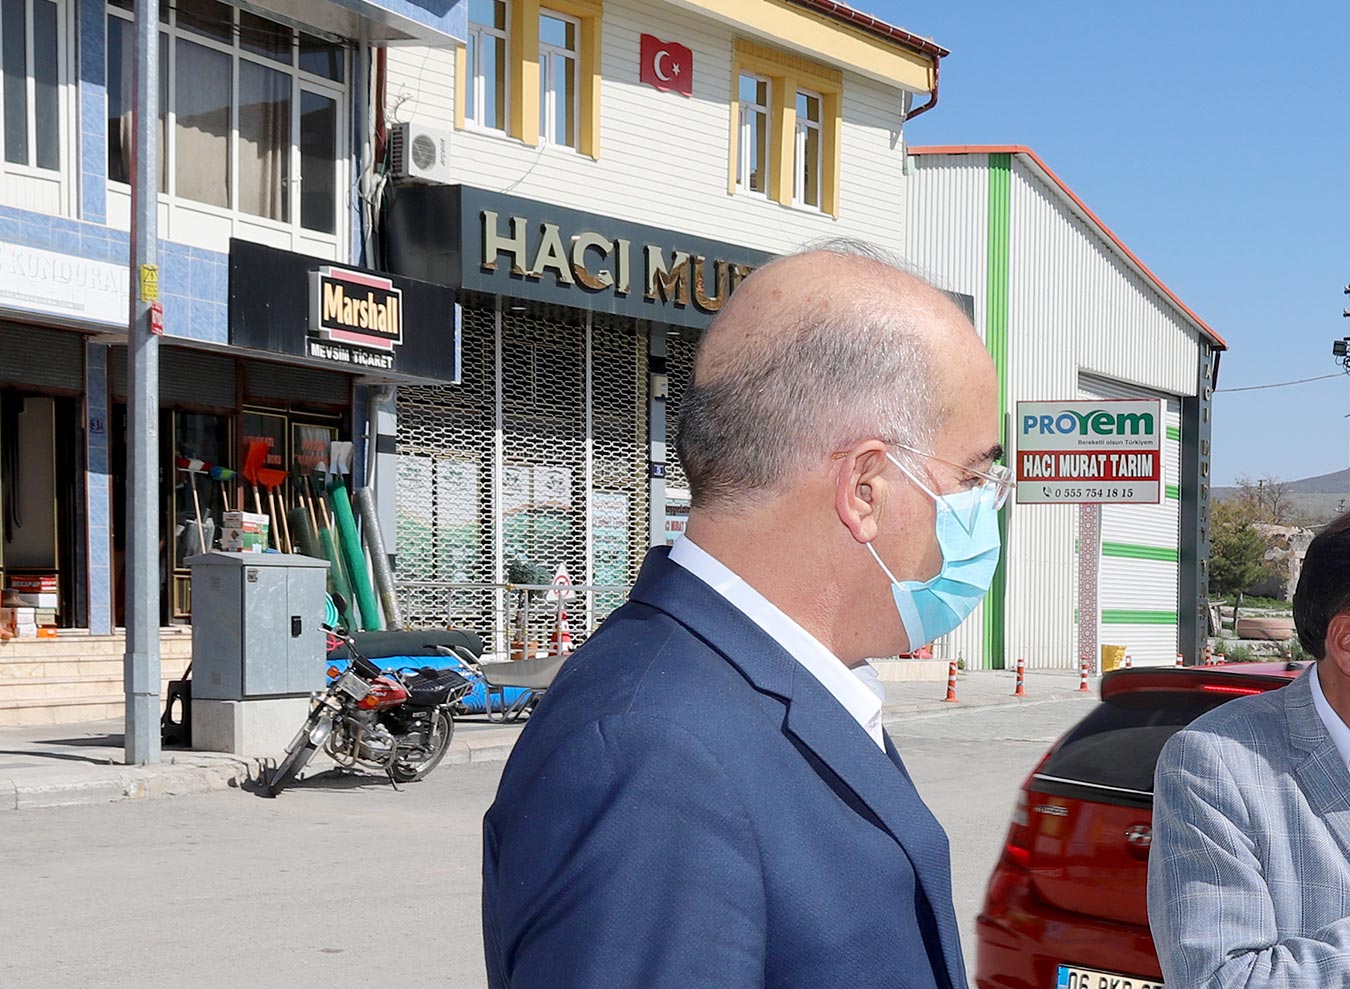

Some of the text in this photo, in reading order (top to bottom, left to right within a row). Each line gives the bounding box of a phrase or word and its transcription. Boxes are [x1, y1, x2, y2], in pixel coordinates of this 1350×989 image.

[481, 210, 631, 298] HACI
[323, 281, 399, 334] Marshall
[1023, 454, 1153, 478] HACI MURAT TARIM
[1055, 488, 1134, 498] 0 555 754 18 15
